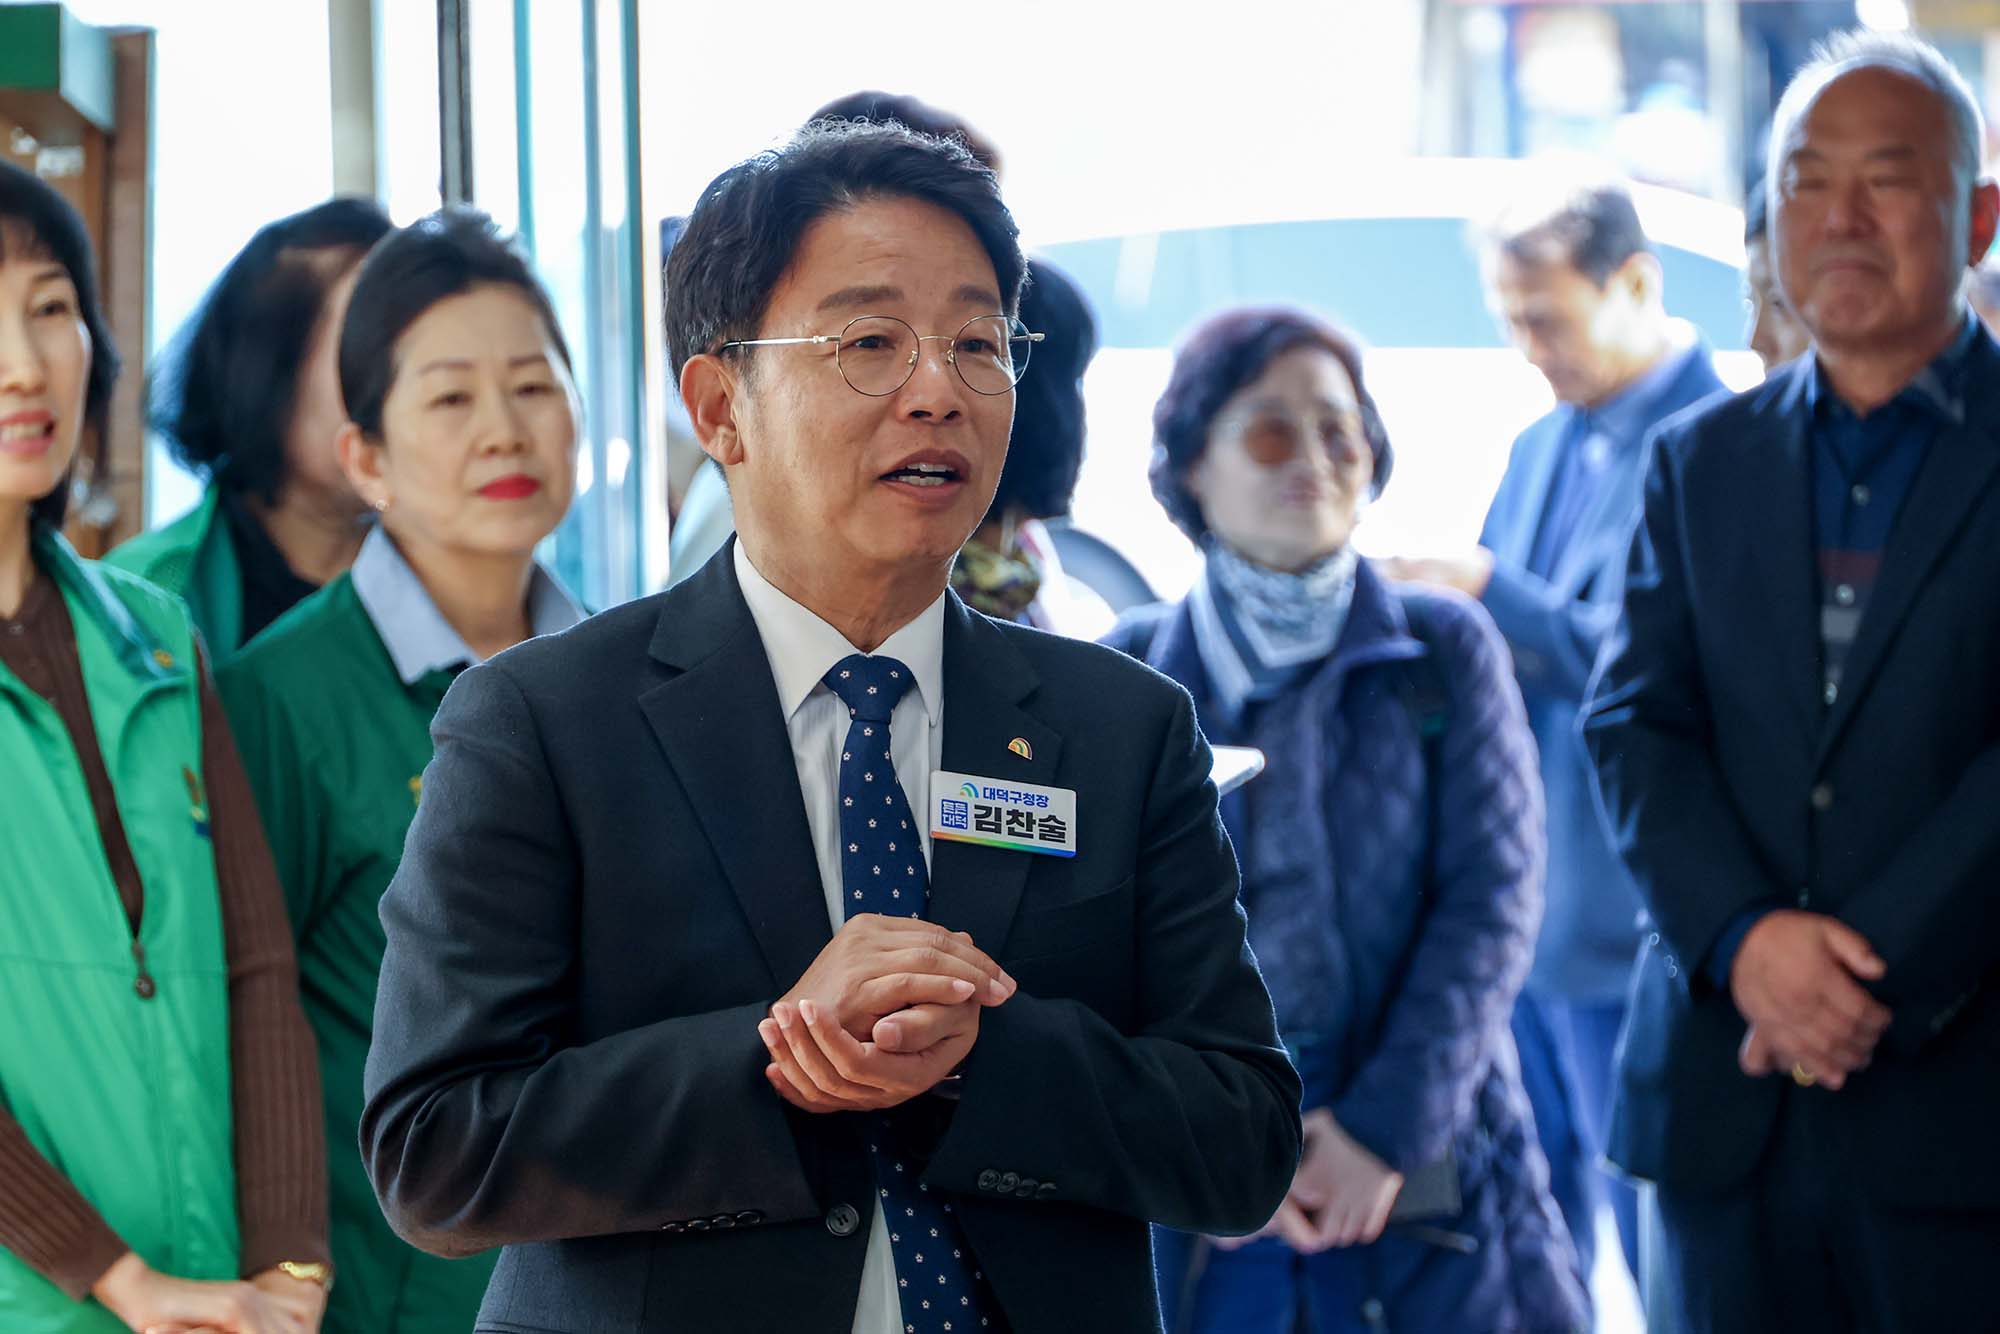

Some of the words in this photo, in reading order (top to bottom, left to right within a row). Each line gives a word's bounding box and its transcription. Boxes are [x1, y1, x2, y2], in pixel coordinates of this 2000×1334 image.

[983, 787, 1049, 808] 대덕구청장
[943, 814, 967, 828] 대덕
[974, 804, 1066, 843] 김찬술
